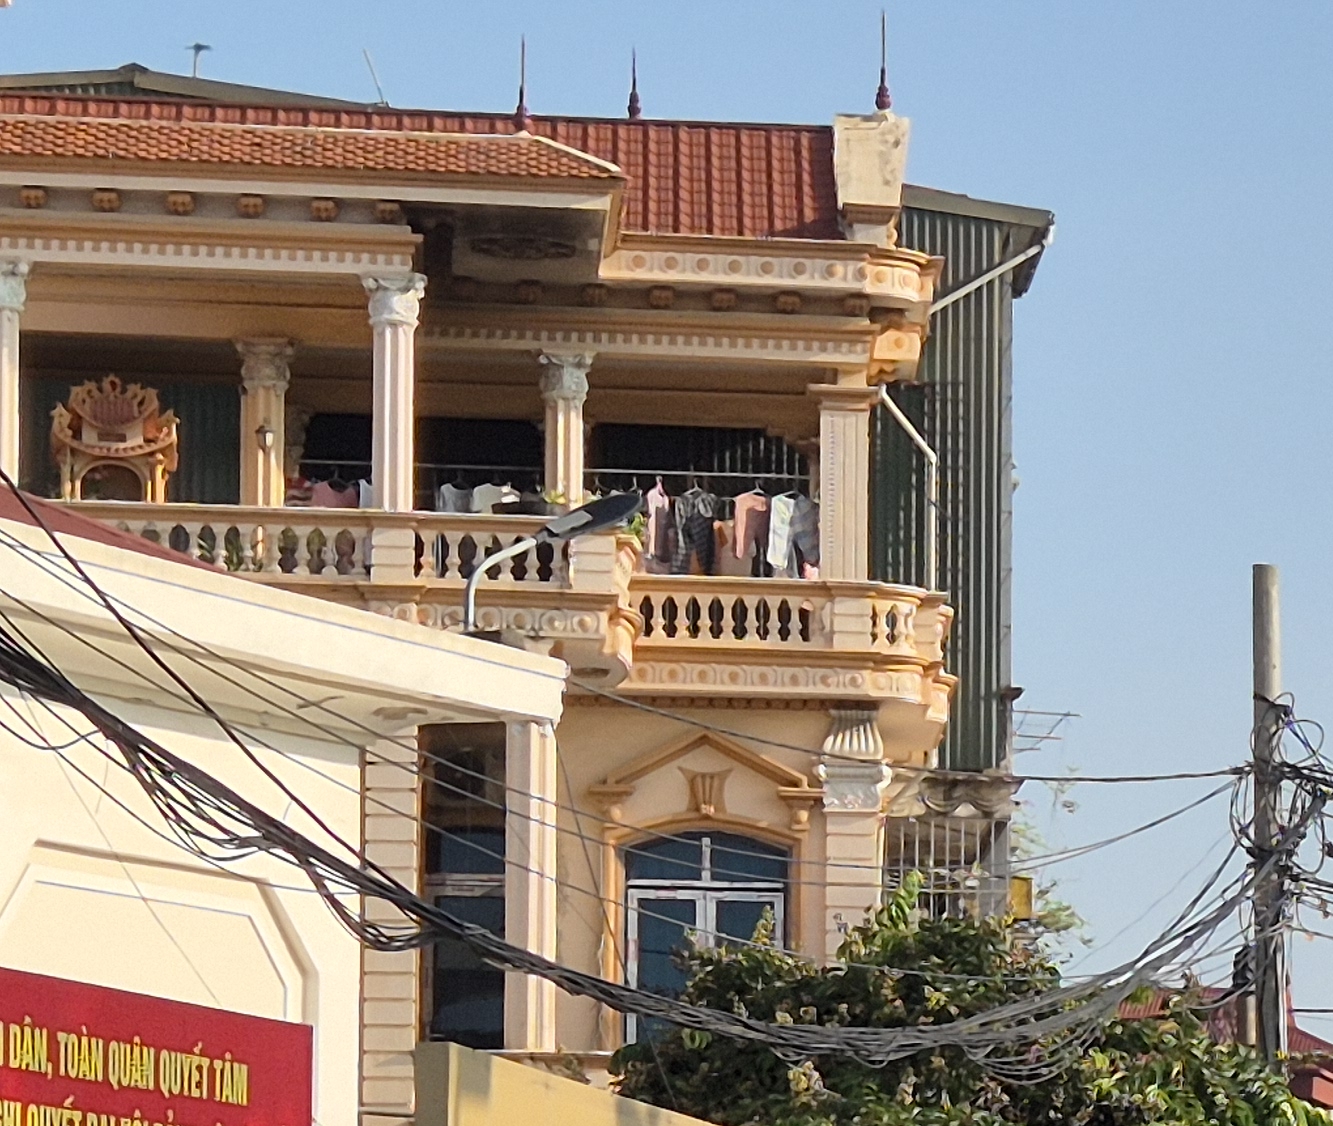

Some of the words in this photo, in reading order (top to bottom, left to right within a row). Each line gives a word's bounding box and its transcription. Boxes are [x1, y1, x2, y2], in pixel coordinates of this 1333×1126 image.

[9, 1014, 53, 1080] DÂN,
[56, 1024, 104, 1083] TOÀN
[108, 1035, 155, 1091] QUÂN
[159, 1041, 211, 1100] QUYẾT
[213, 1051, 248, 1107] TÂM
